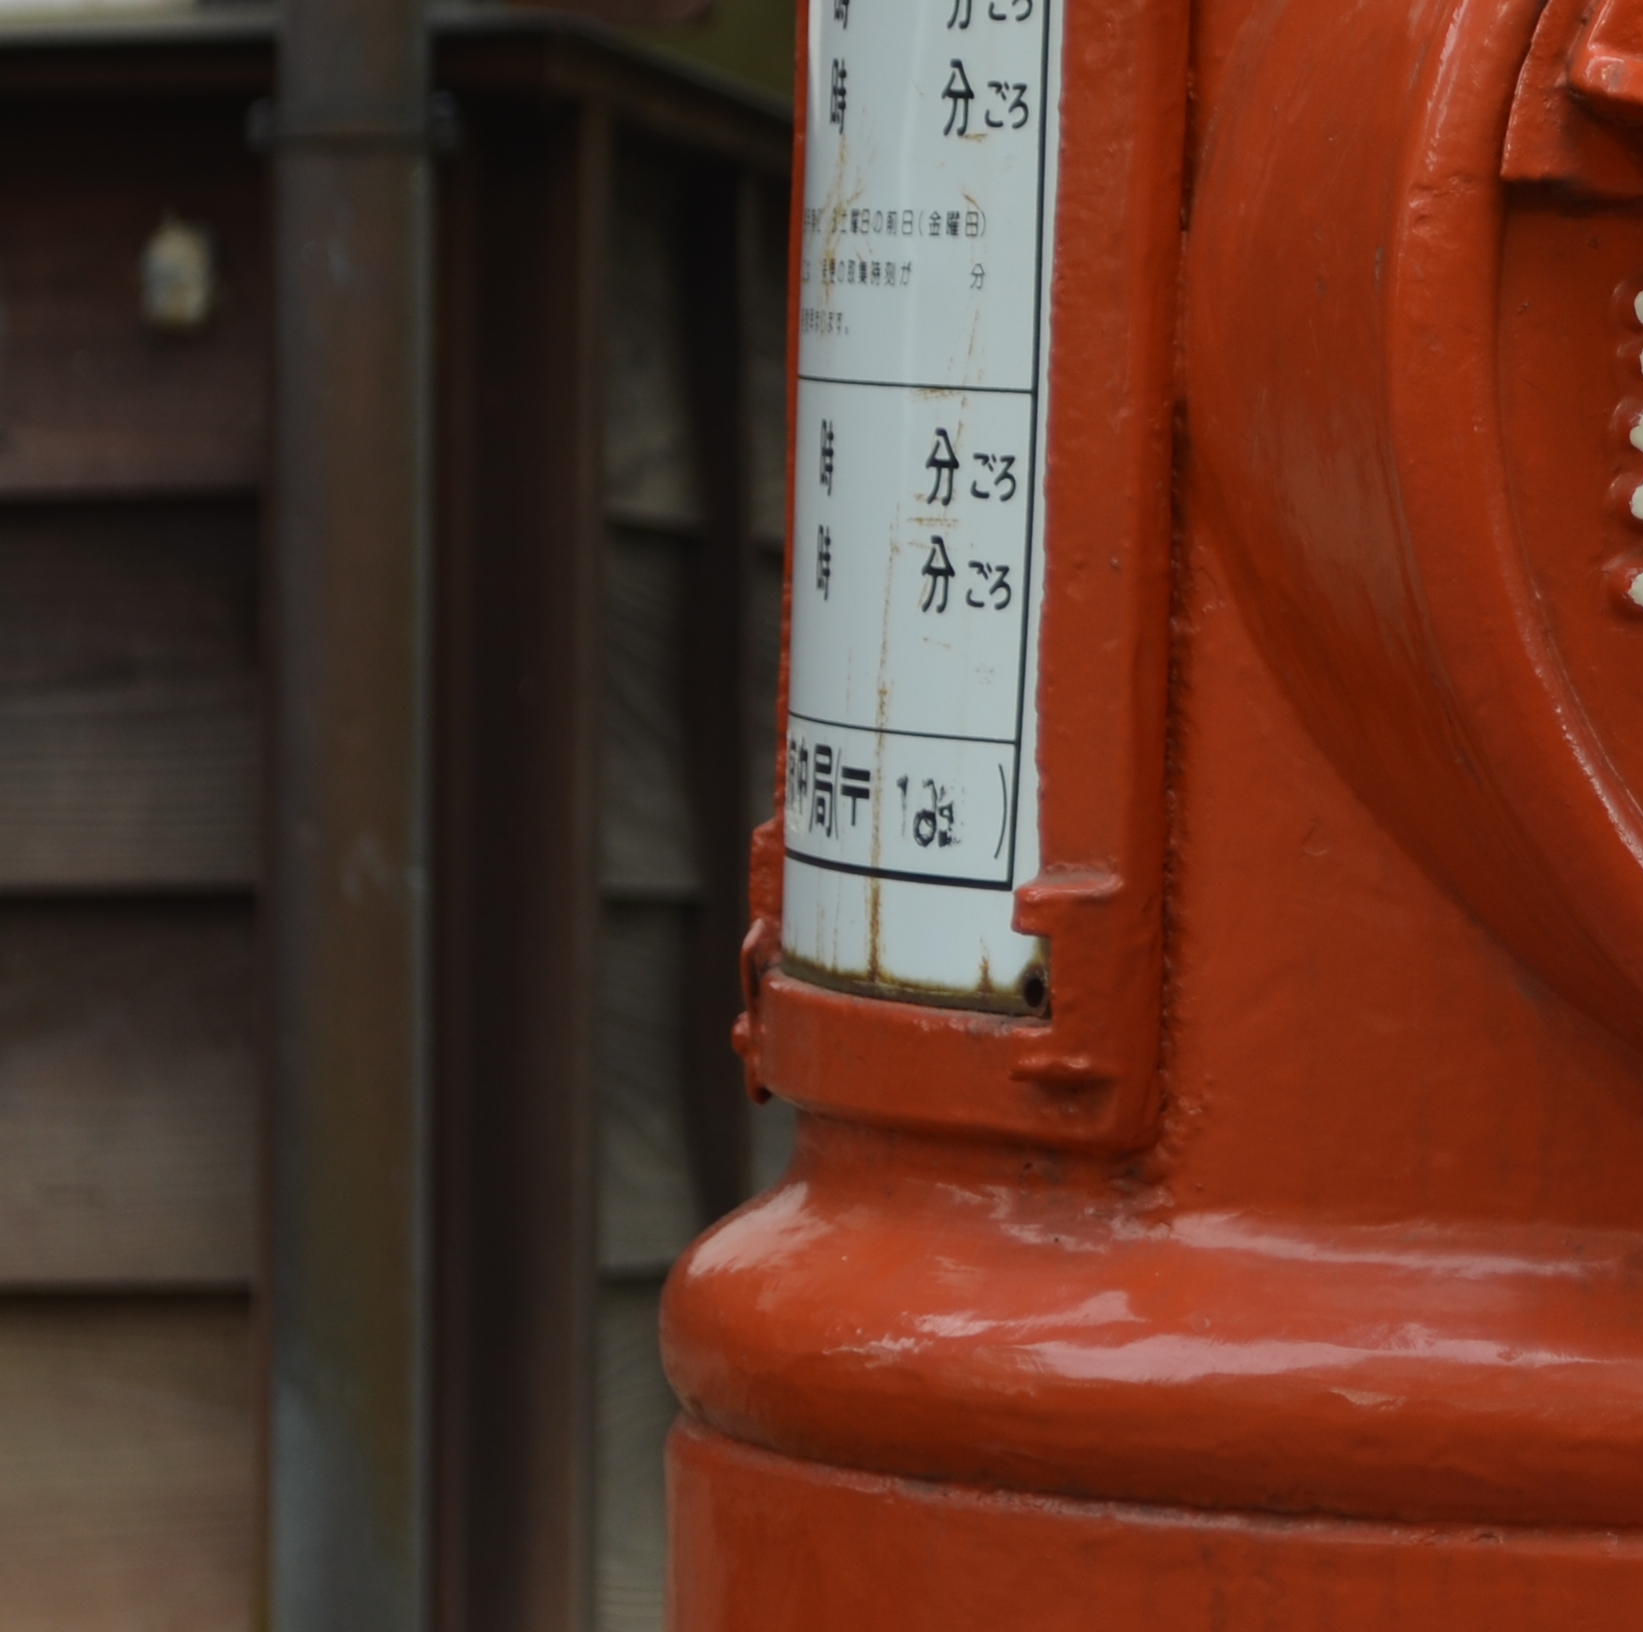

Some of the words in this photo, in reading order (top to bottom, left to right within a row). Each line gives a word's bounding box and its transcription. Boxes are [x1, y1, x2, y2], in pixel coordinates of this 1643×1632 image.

[830, 57, 847, 134] 時
[941, 58, 1029, 136] 分ごろ
[969, 263, 986, 289] 分
[819, 419, 834, 496] 時
[925, 427, 1017, 506] 分ごろ
[816, 524, 831, 601] 時
[921, 534, 1012, 614] 分ごろ
